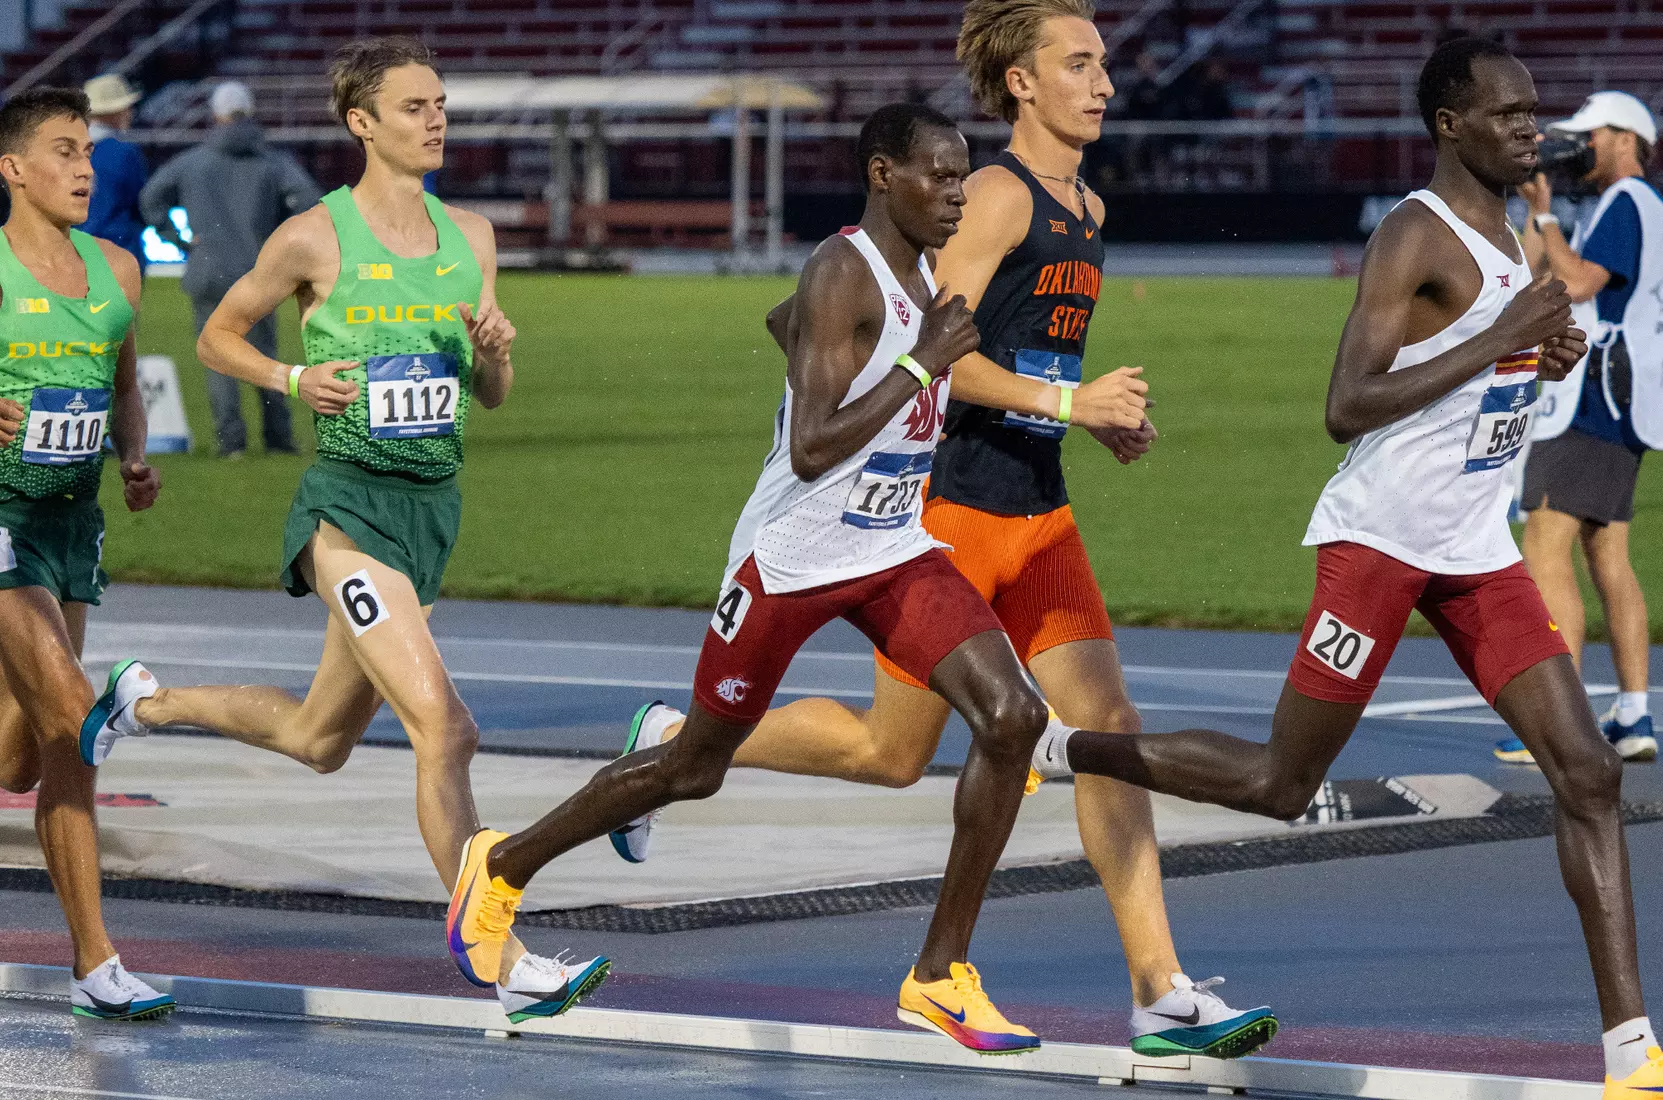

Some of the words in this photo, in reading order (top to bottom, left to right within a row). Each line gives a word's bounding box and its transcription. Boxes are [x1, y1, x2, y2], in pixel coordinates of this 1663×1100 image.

[346, 304, 474, 325] DUCK
[382, 385, 452, 424] 1112
[37, 418, 102, 452] 1110
[1487, 413, 1528, 456] 599
[856, 479, 922, 516] 1733
[341, 578, 379, 627] 6
[716, 586, 744, 637] 4
[1313, 618, 1361, 670] 20
